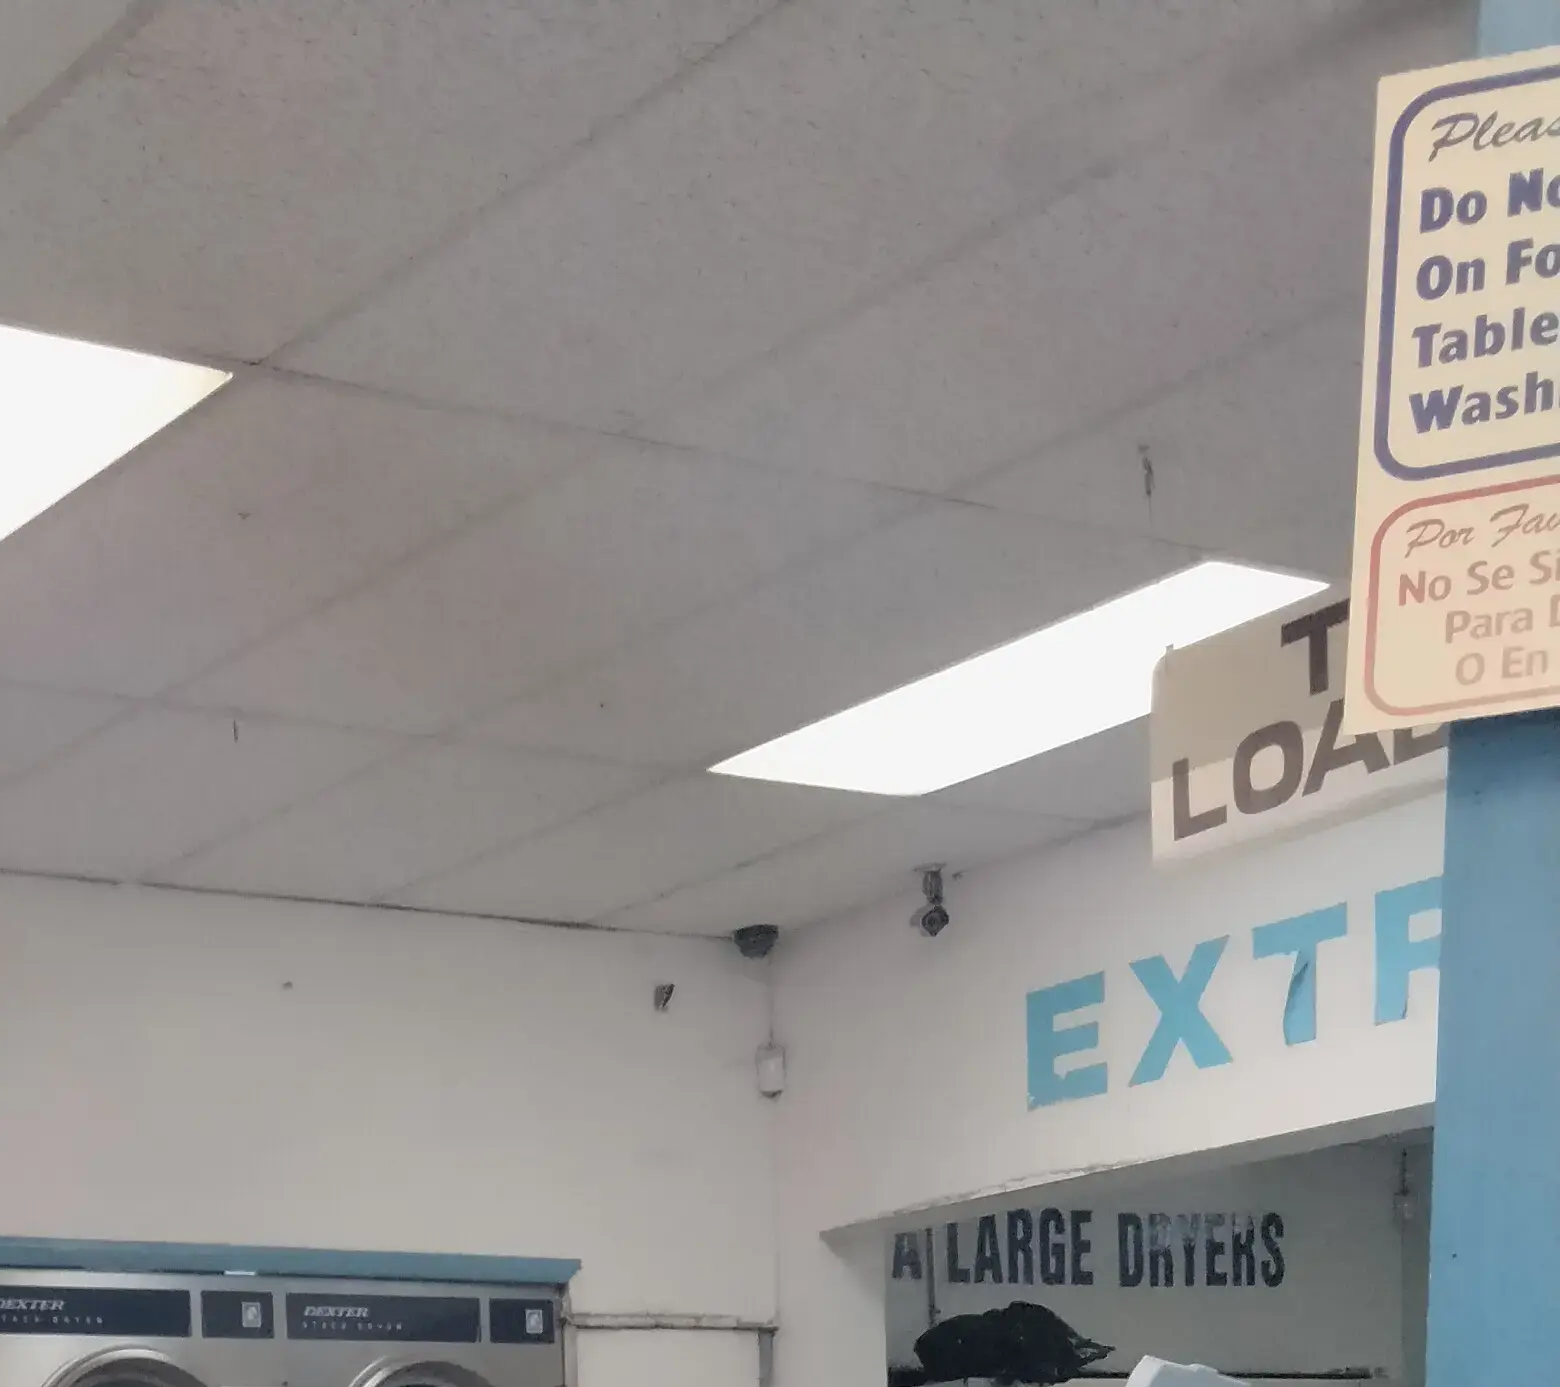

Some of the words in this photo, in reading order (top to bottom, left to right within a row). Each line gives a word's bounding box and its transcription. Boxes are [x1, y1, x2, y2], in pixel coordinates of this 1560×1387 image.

[1419, 186, 1488, 234] Do
[1416, 255, 1486, 301] On
[1405, 518, 1474, 558] Por
[1398, 570, 1452, 606] No
[1467, 560, 1515, 595] Se
[1445, 607, 1534, 643] Para
[1455, 652, 1485, 686] O
[1502, 645, 1549, 679] En
[946, 1208, 1095, 1285] LARGE
[1117, 1211, 1287, 1288] DRYERS
